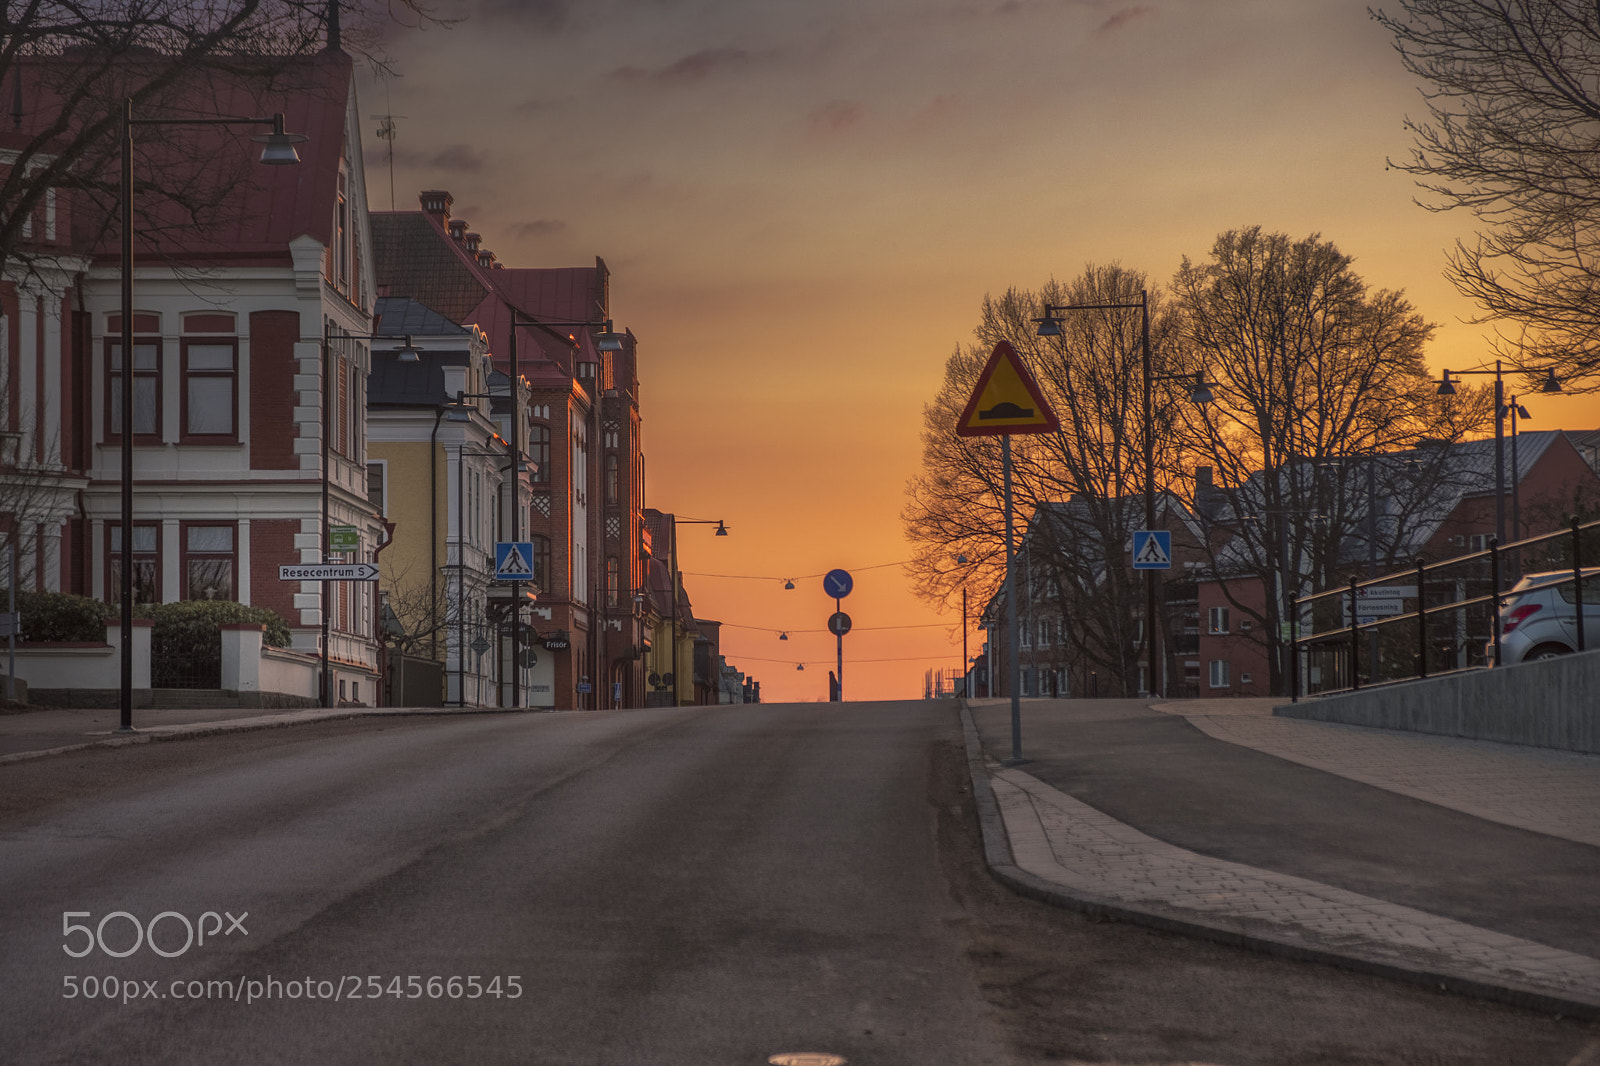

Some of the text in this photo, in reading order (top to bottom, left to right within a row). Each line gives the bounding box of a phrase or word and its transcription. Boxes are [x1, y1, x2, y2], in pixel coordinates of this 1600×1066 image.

[282, 567, 365, 577] Resecentrum S
[546, 641, 568, 649] Frisör
